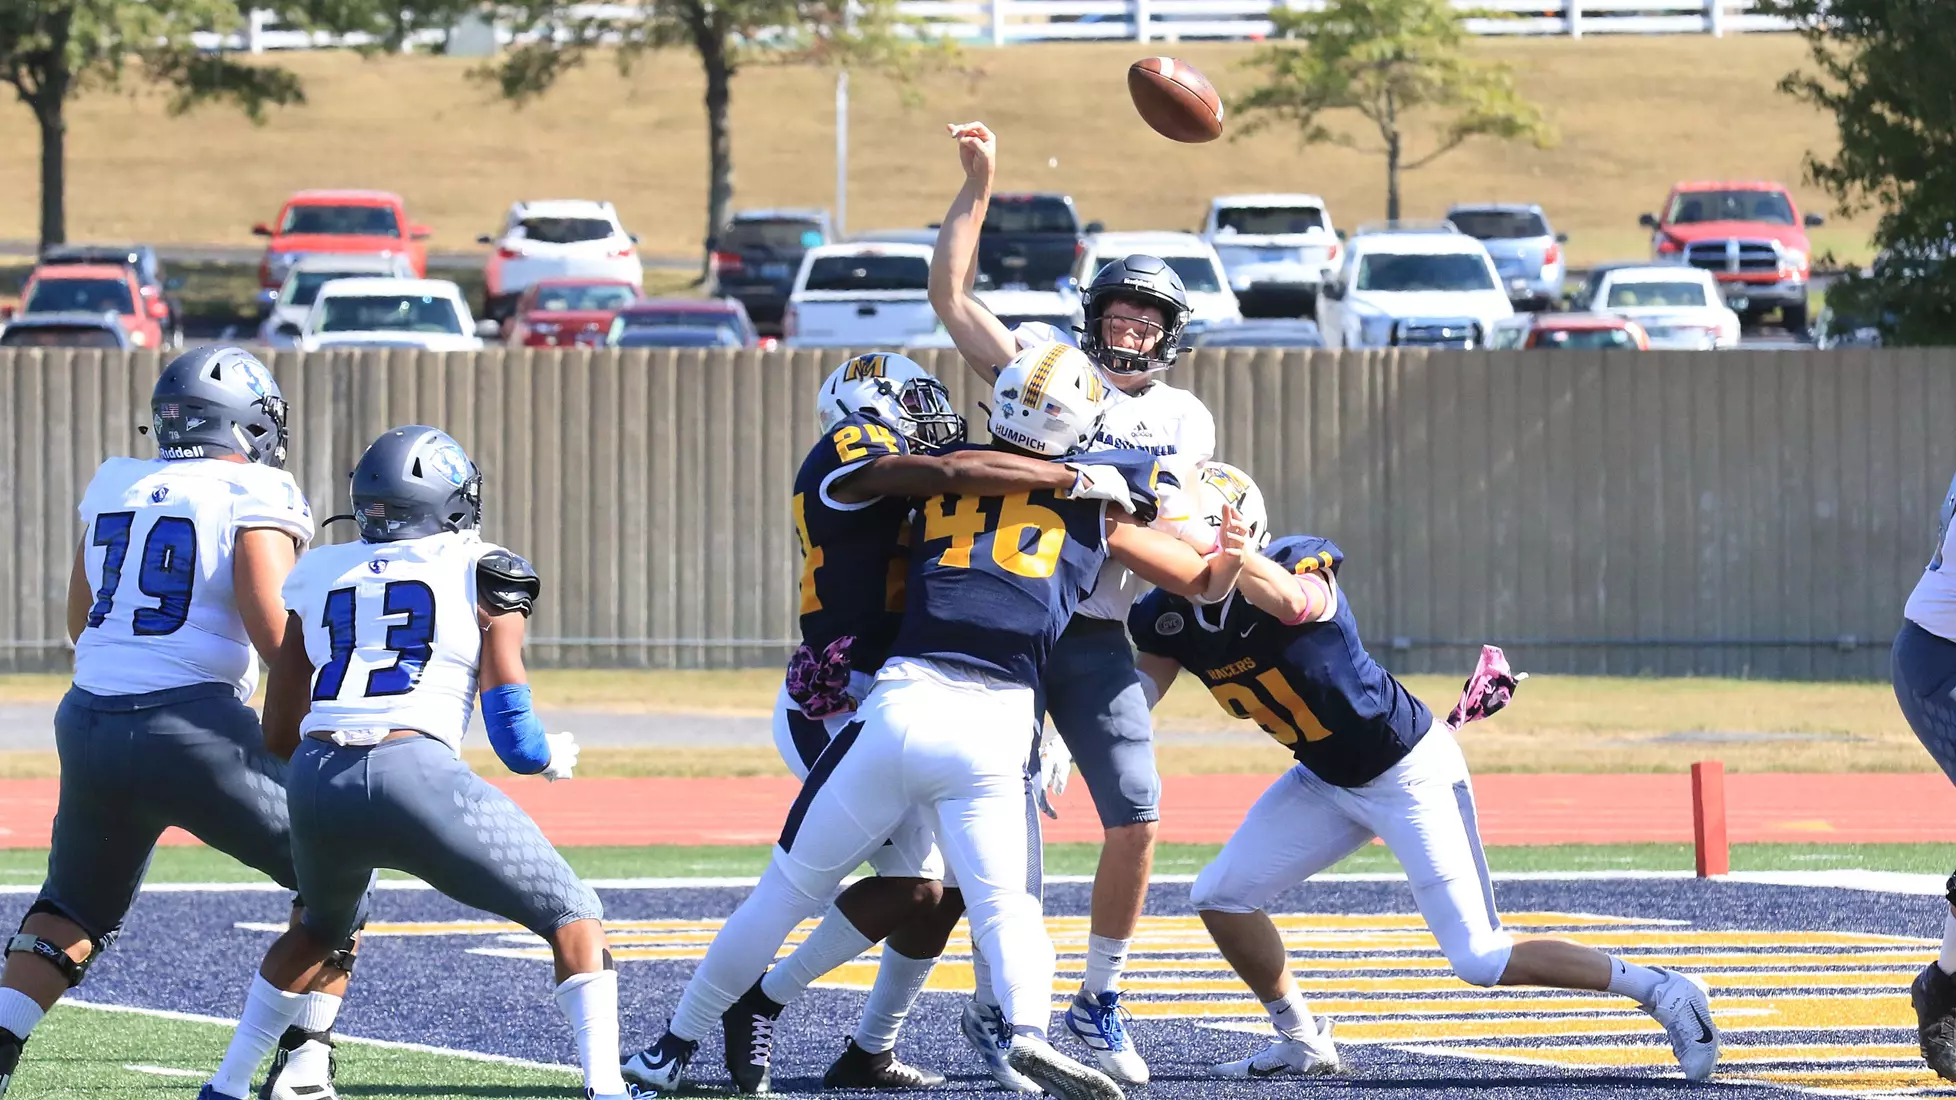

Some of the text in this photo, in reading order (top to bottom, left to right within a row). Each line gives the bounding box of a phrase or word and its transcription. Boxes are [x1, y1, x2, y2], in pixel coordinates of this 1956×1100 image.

[160, 445, 204, 460] Riddell
[833, 423, 900, 463] 24
[995, 423, 1046, 451] HUMPICH
[924, 488, 1072, 578] 46
[88, 511, 198, 635] 79
[312, 579, 436, 701] 13
[1206, 656, 1257, 680] RACERS
[1209, 667, 1333, 745] 91
